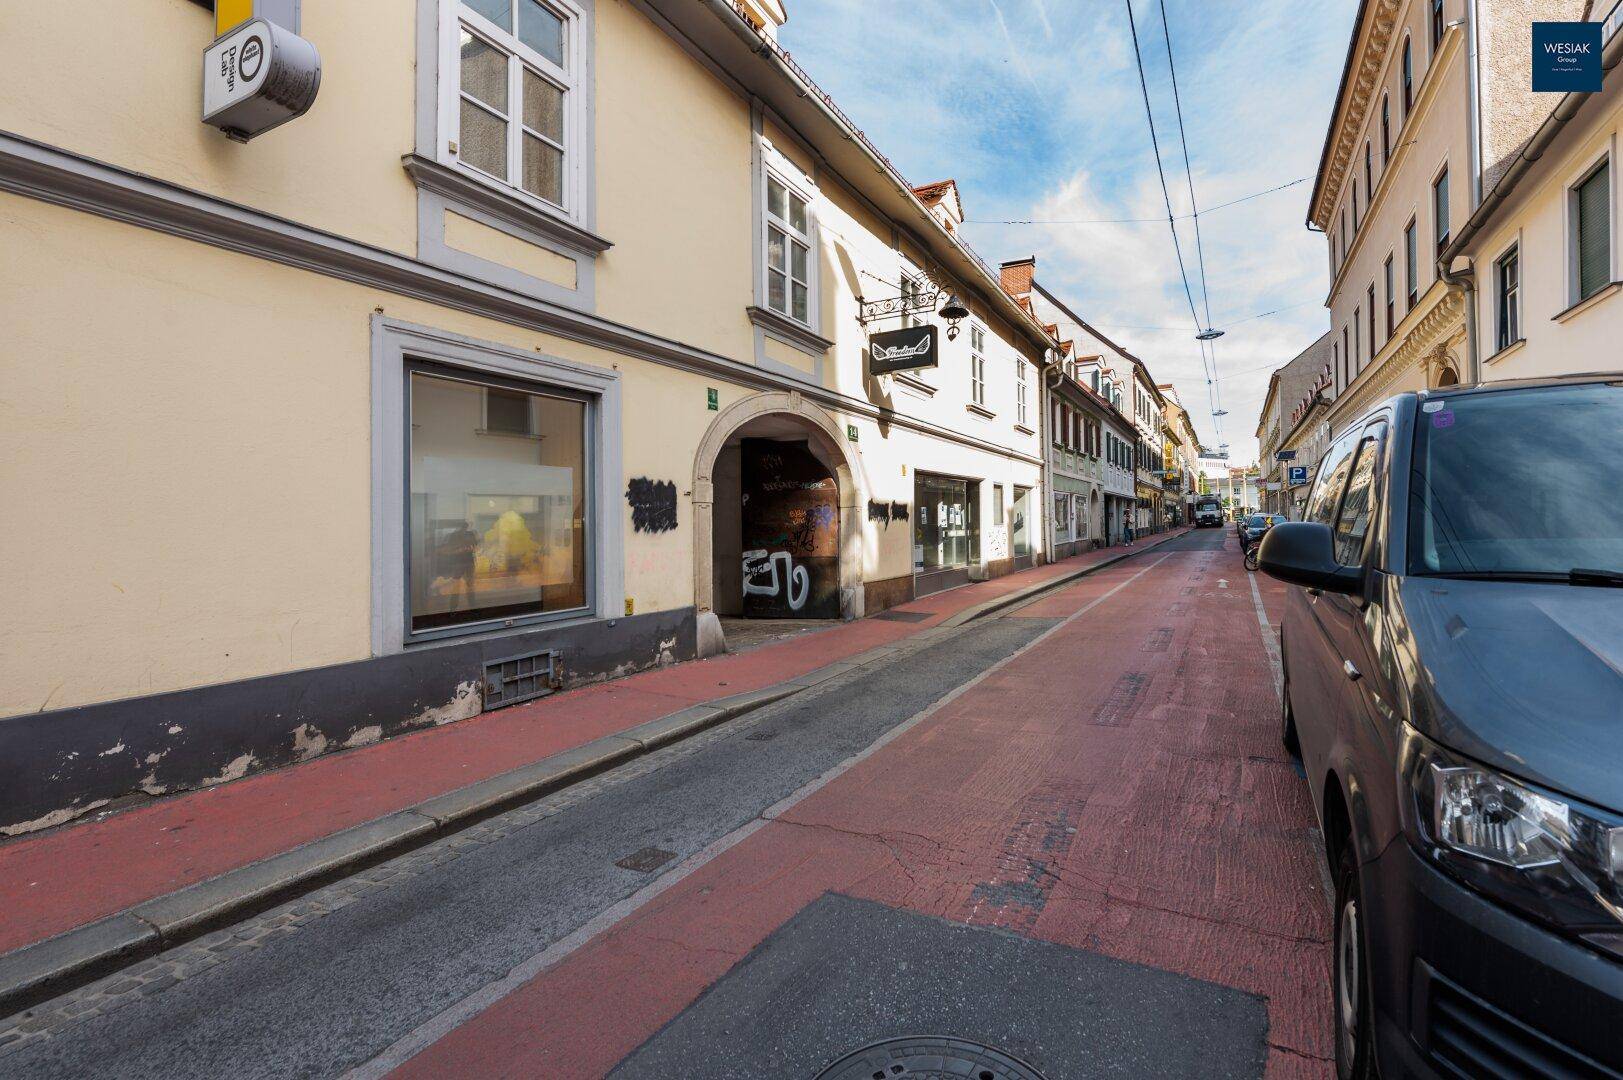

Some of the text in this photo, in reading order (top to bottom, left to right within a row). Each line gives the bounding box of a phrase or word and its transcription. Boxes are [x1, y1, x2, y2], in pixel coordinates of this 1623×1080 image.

[245, 44, 257, 54] white
[221, 49, 229, 77] Lab
[227, 45, 237, 93] Design
[887, 346, 915, 357] Freedom
[849, 427, 858, 437] 14
[1293, 468, 1303, 478] P
